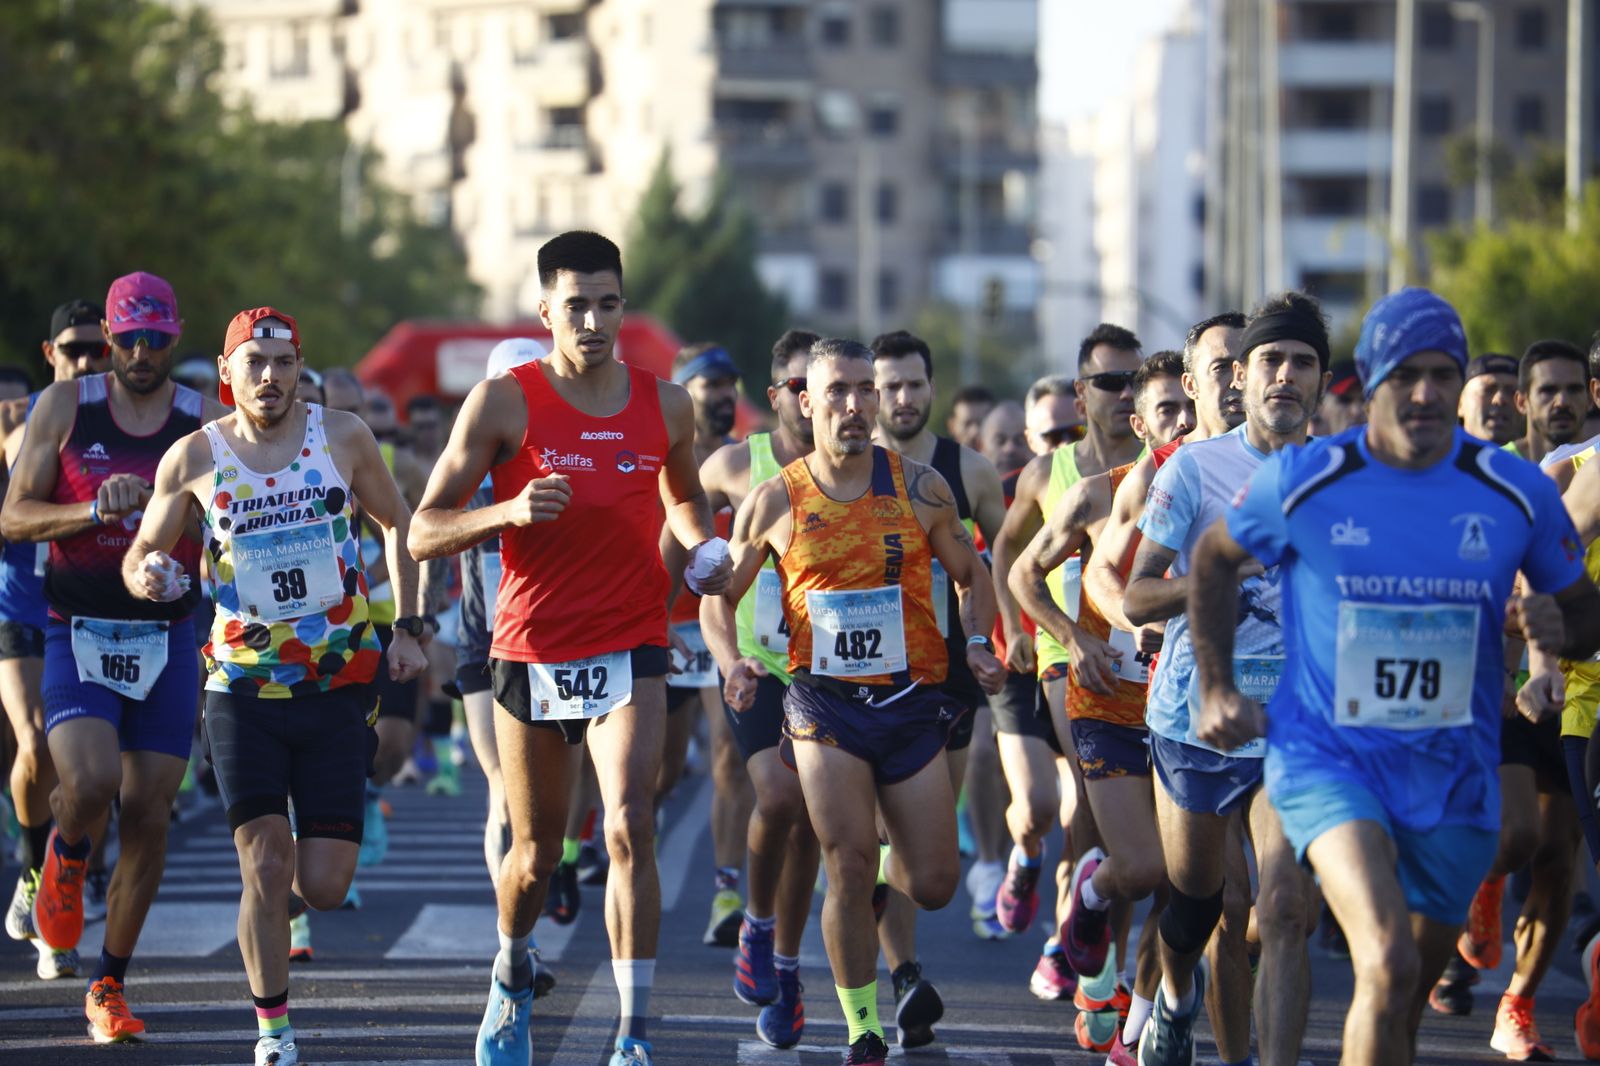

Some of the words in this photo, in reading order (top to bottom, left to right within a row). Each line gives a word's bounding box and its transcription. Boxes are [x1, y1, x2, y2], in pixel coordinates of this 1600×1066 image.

[552, 454, 593, 467] califas
[229, 484, 326, 515] TRIATLÓN
[235, 506, 316, 534] RONDA
[236, 547, 273, 561] MEDIA
[276, 537, 332, 555] MARATÓN
[271, 567, 308, 603] 39
[1335, 575, 1494, 600] TROTASIERRA
[811, 607, 844, 618] MEDIA
[847, 601, 900, 617] MARATÓN
[777, 615, 791, 638] 4
[834, 628, 883, 661] 482
[100, 653, 141, 684] 165
[1242, 675, 1281, 687] MARAT
[1375, 658, 1441, 701] 579
[554, 666, 609, 701] 542
